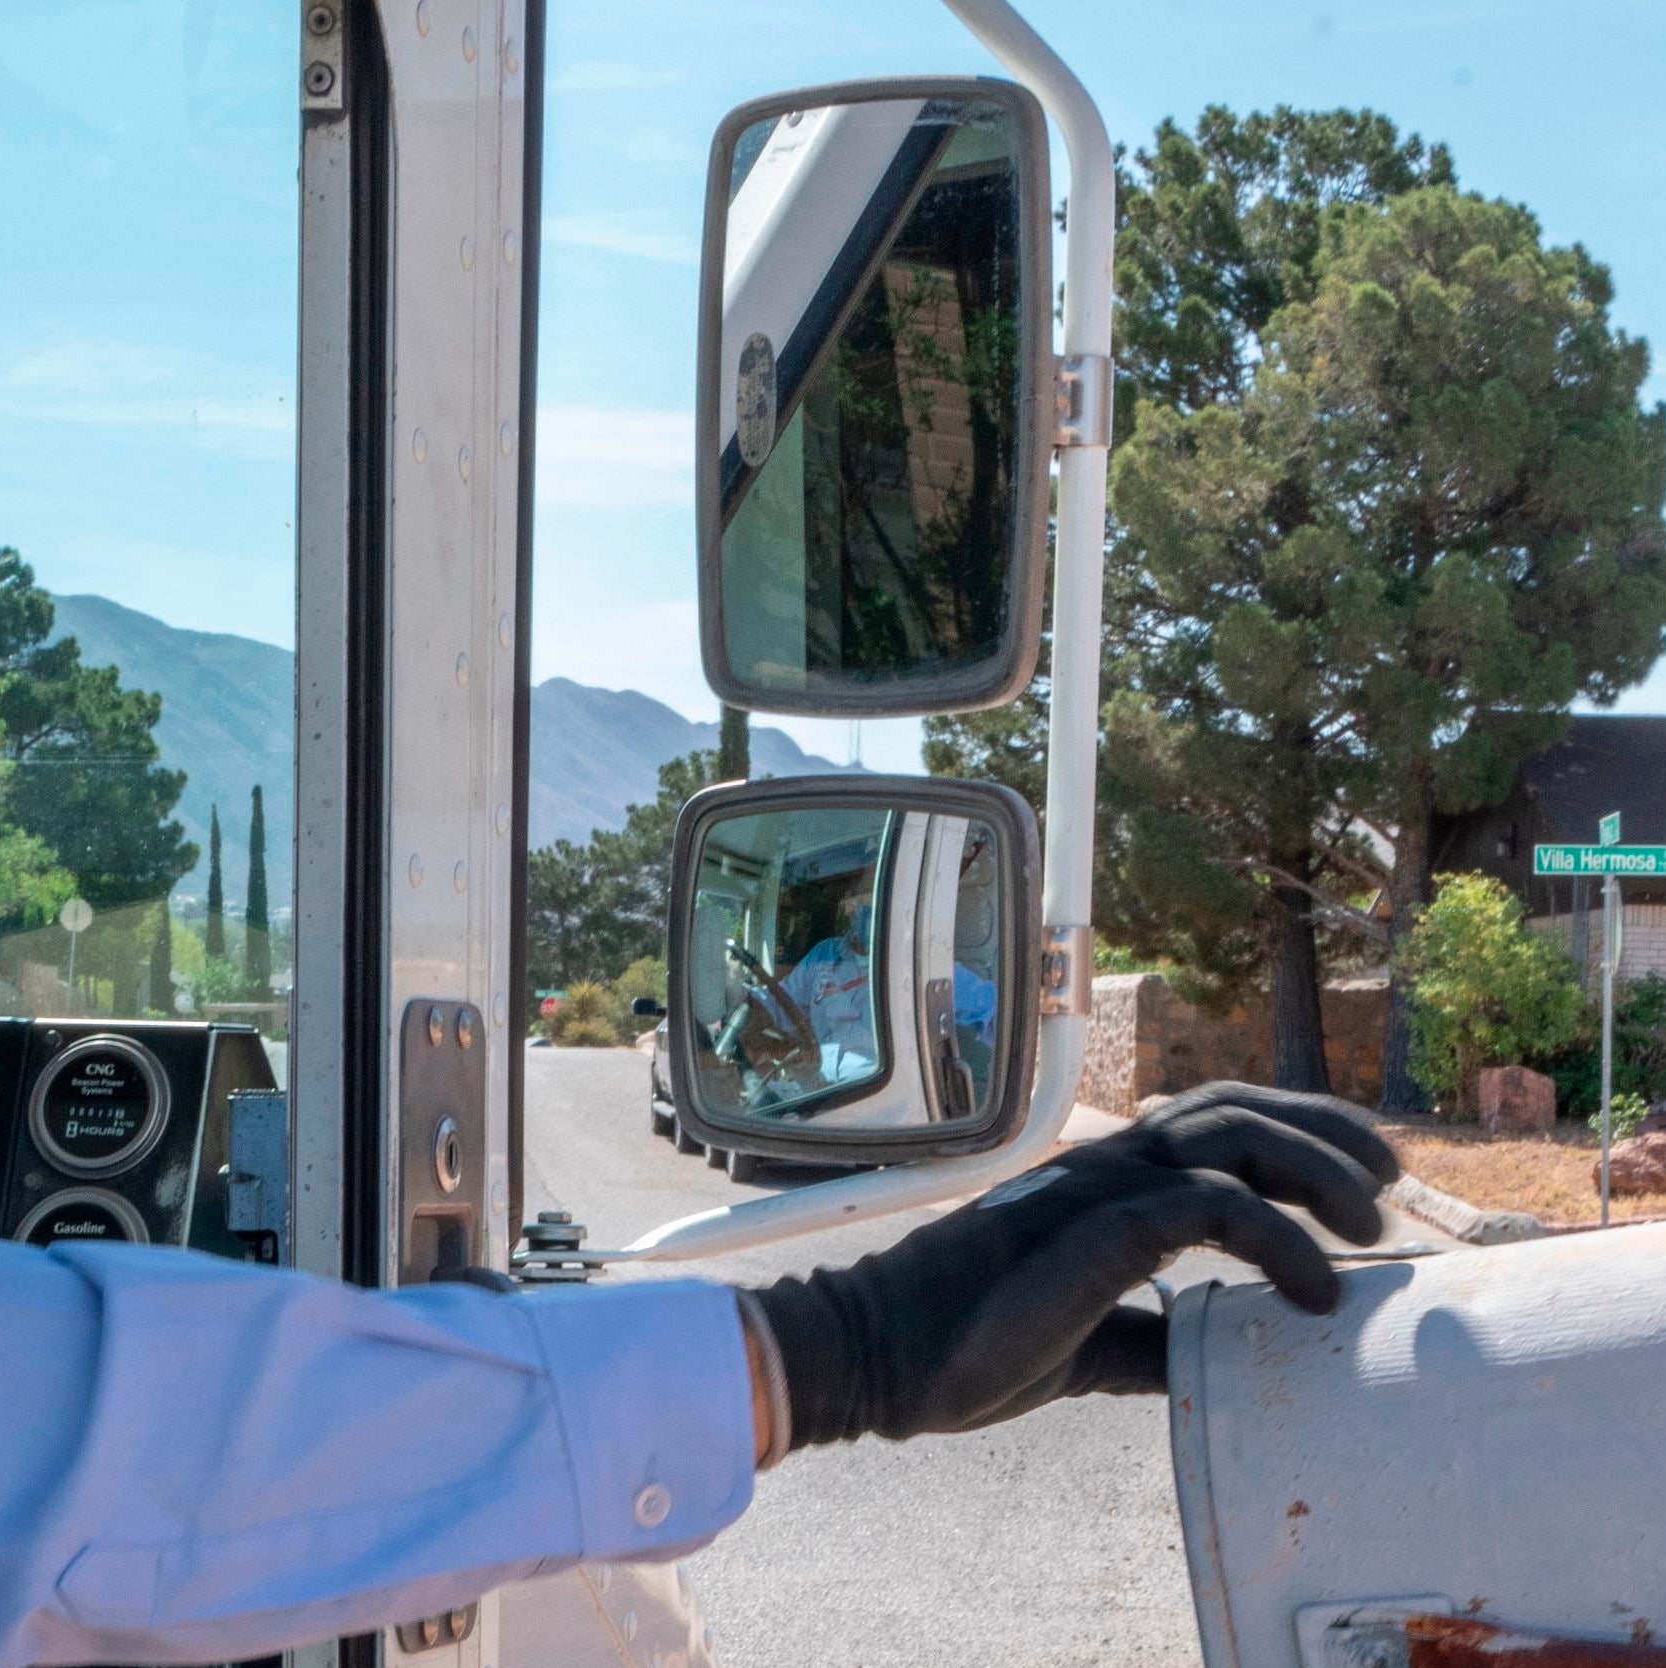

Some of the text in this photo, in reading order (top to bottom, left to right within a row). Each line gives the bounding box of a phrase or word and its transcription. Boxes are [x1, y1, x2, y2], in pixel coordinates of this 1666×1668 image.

[1539, 848, 1575, 870] Villa
[1580, 848, 1657, 870] Hermosa
[85, 1063, 115, 1076] CNG
[79, 1125, 125, 1137] HOURS
[53, 1220, 106, 1235] Gasoline
